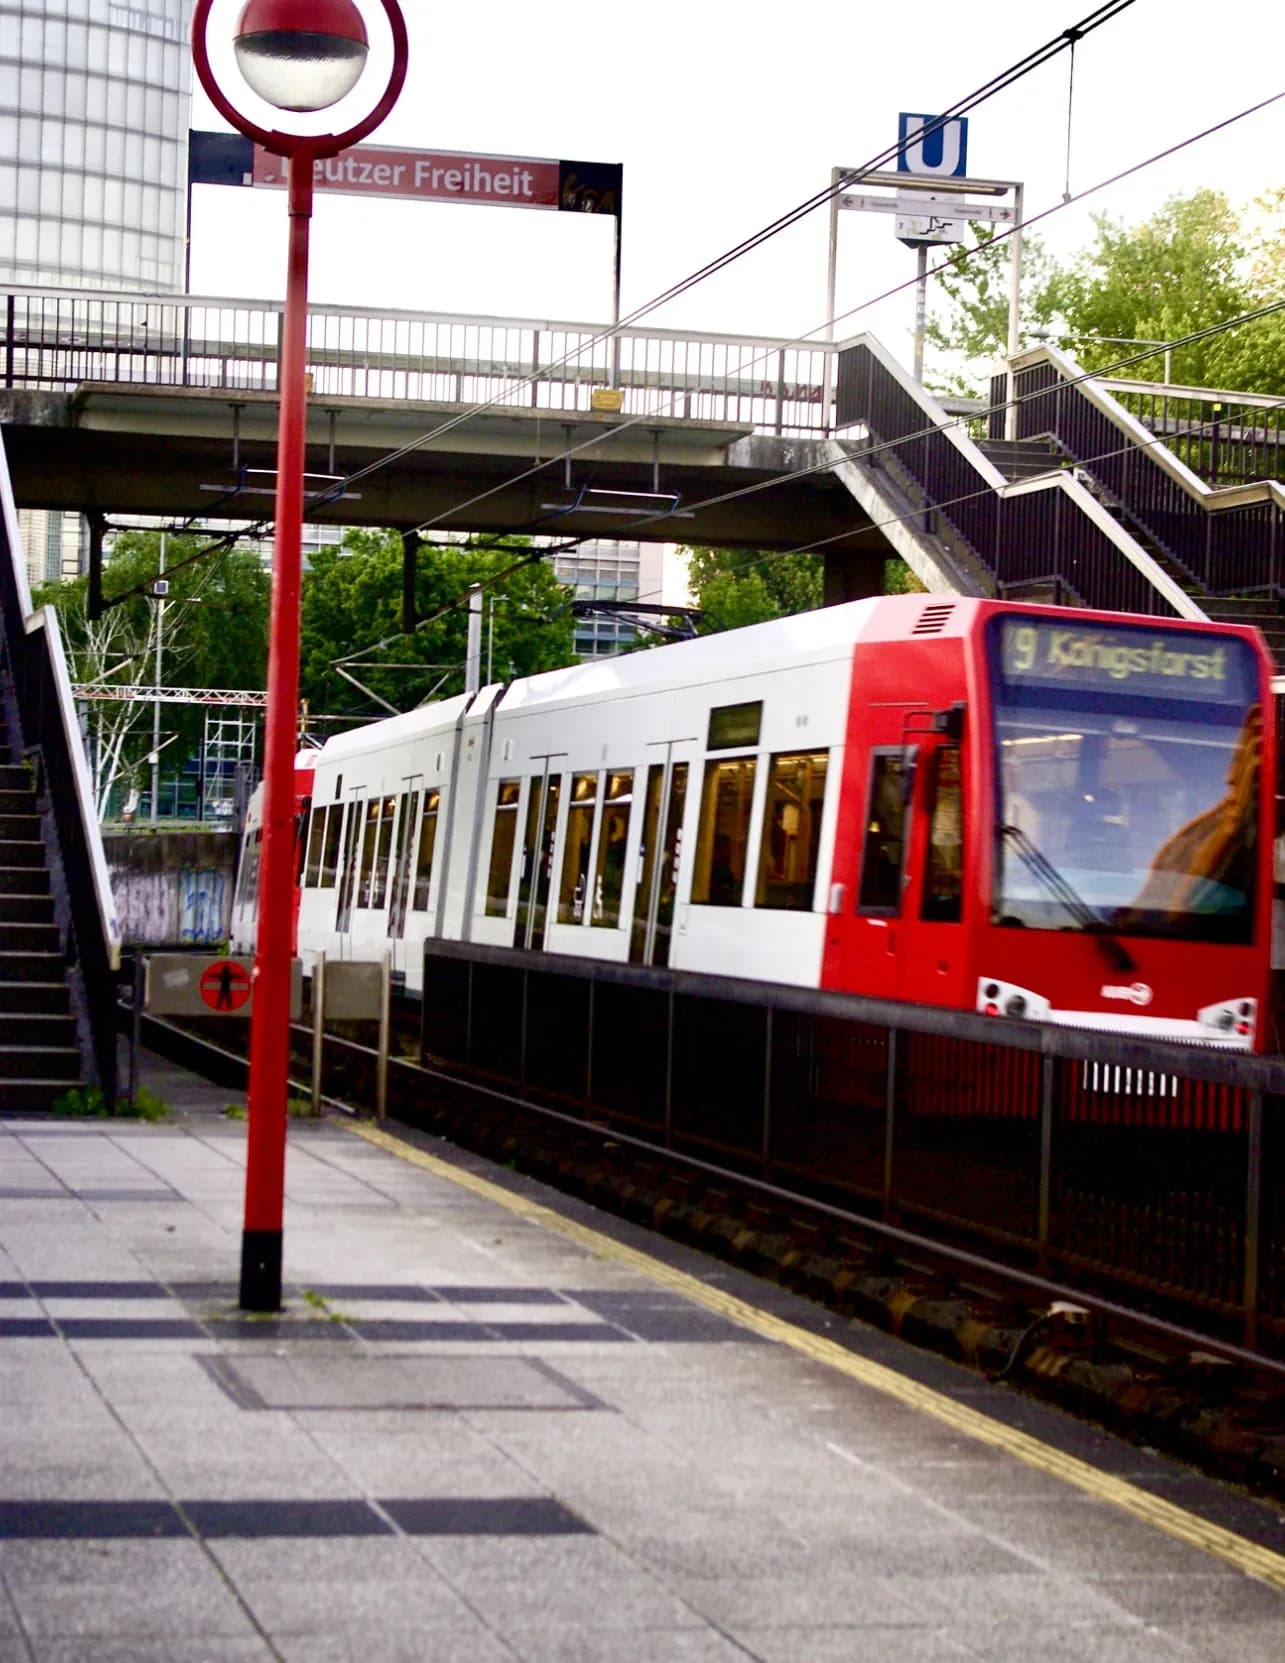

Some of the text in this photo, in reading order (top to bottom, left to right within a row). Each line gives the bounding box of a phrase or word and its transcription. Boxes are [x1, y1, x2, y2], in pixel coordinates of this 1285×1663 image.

[904, 116, 962, 177] U
[414, 159, 534, 197] Freiheit
[1013, 626, 1038, 671] 9
